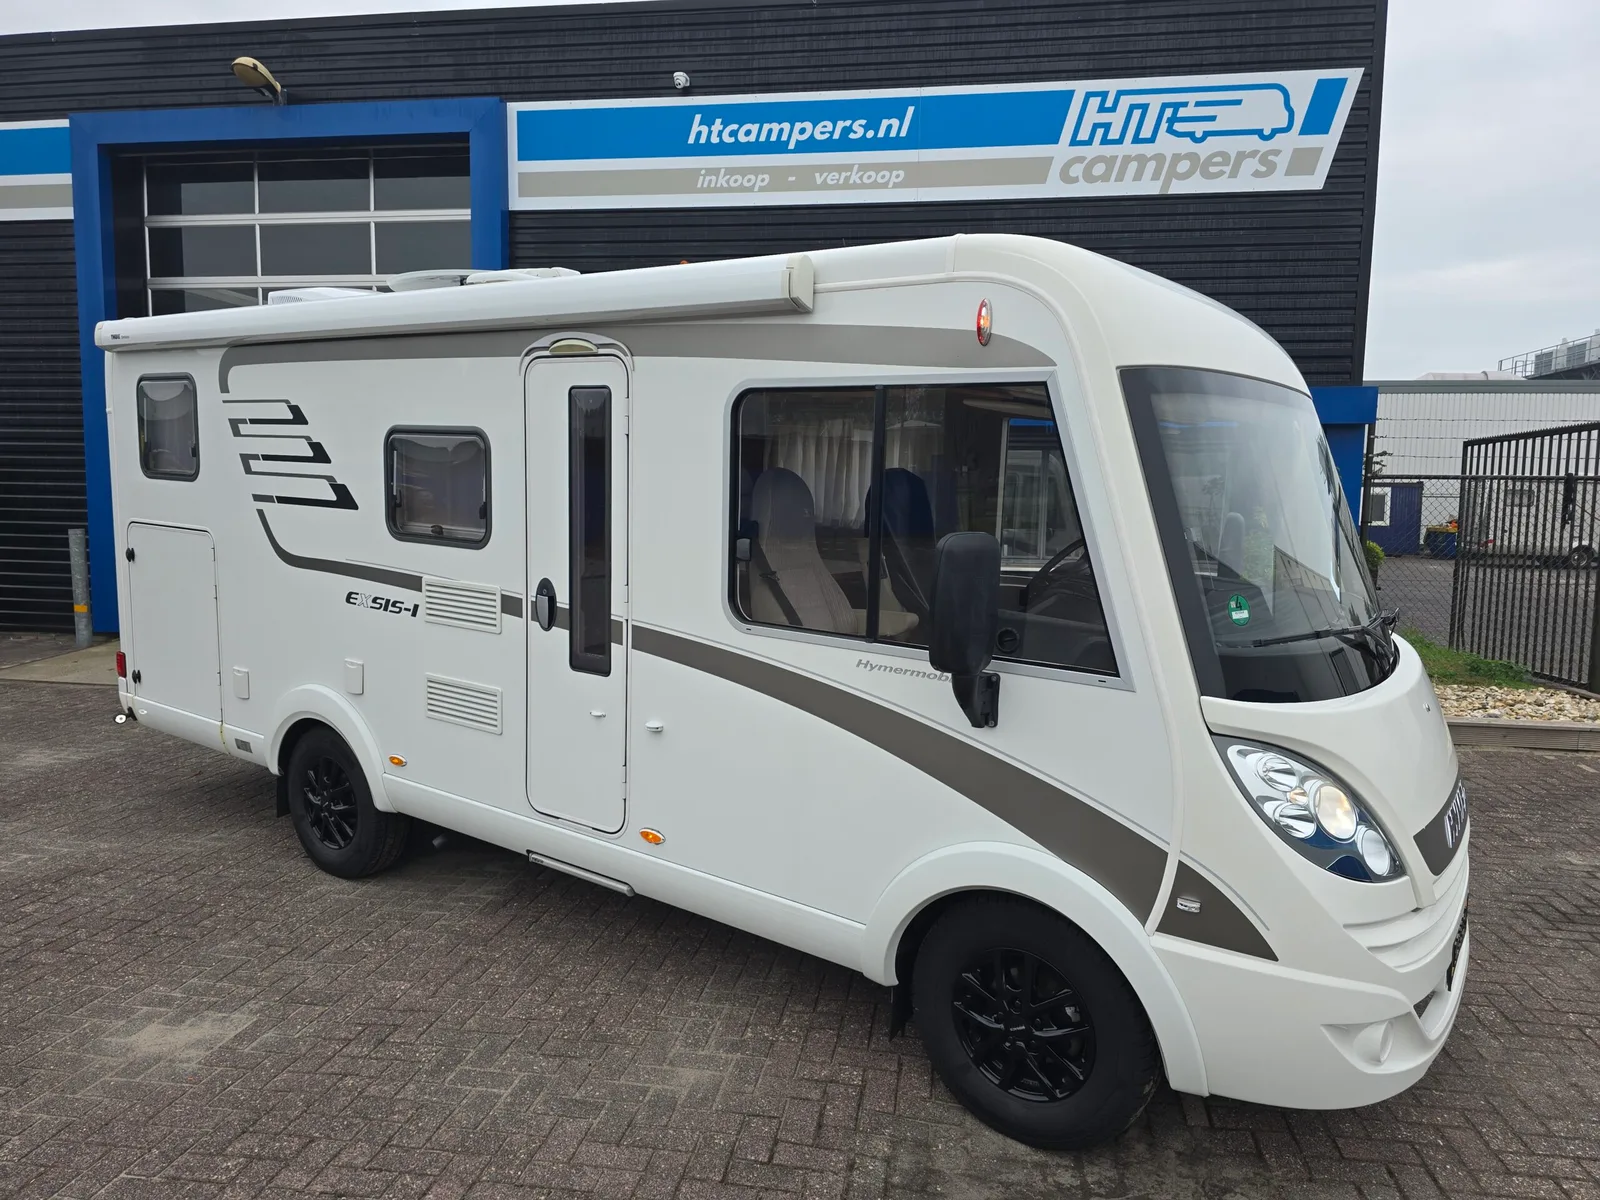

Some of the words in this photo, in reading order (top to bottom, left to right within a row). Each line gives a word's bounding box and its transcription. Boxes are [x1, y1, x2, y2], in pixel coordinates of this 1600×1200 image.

[687, 105, 915, 149] htcampers.nl
[697, 169, 770, 192] inkoop
[814, 164, 905, 188] verkoop
[1058, 148, 1283, 194] campers
